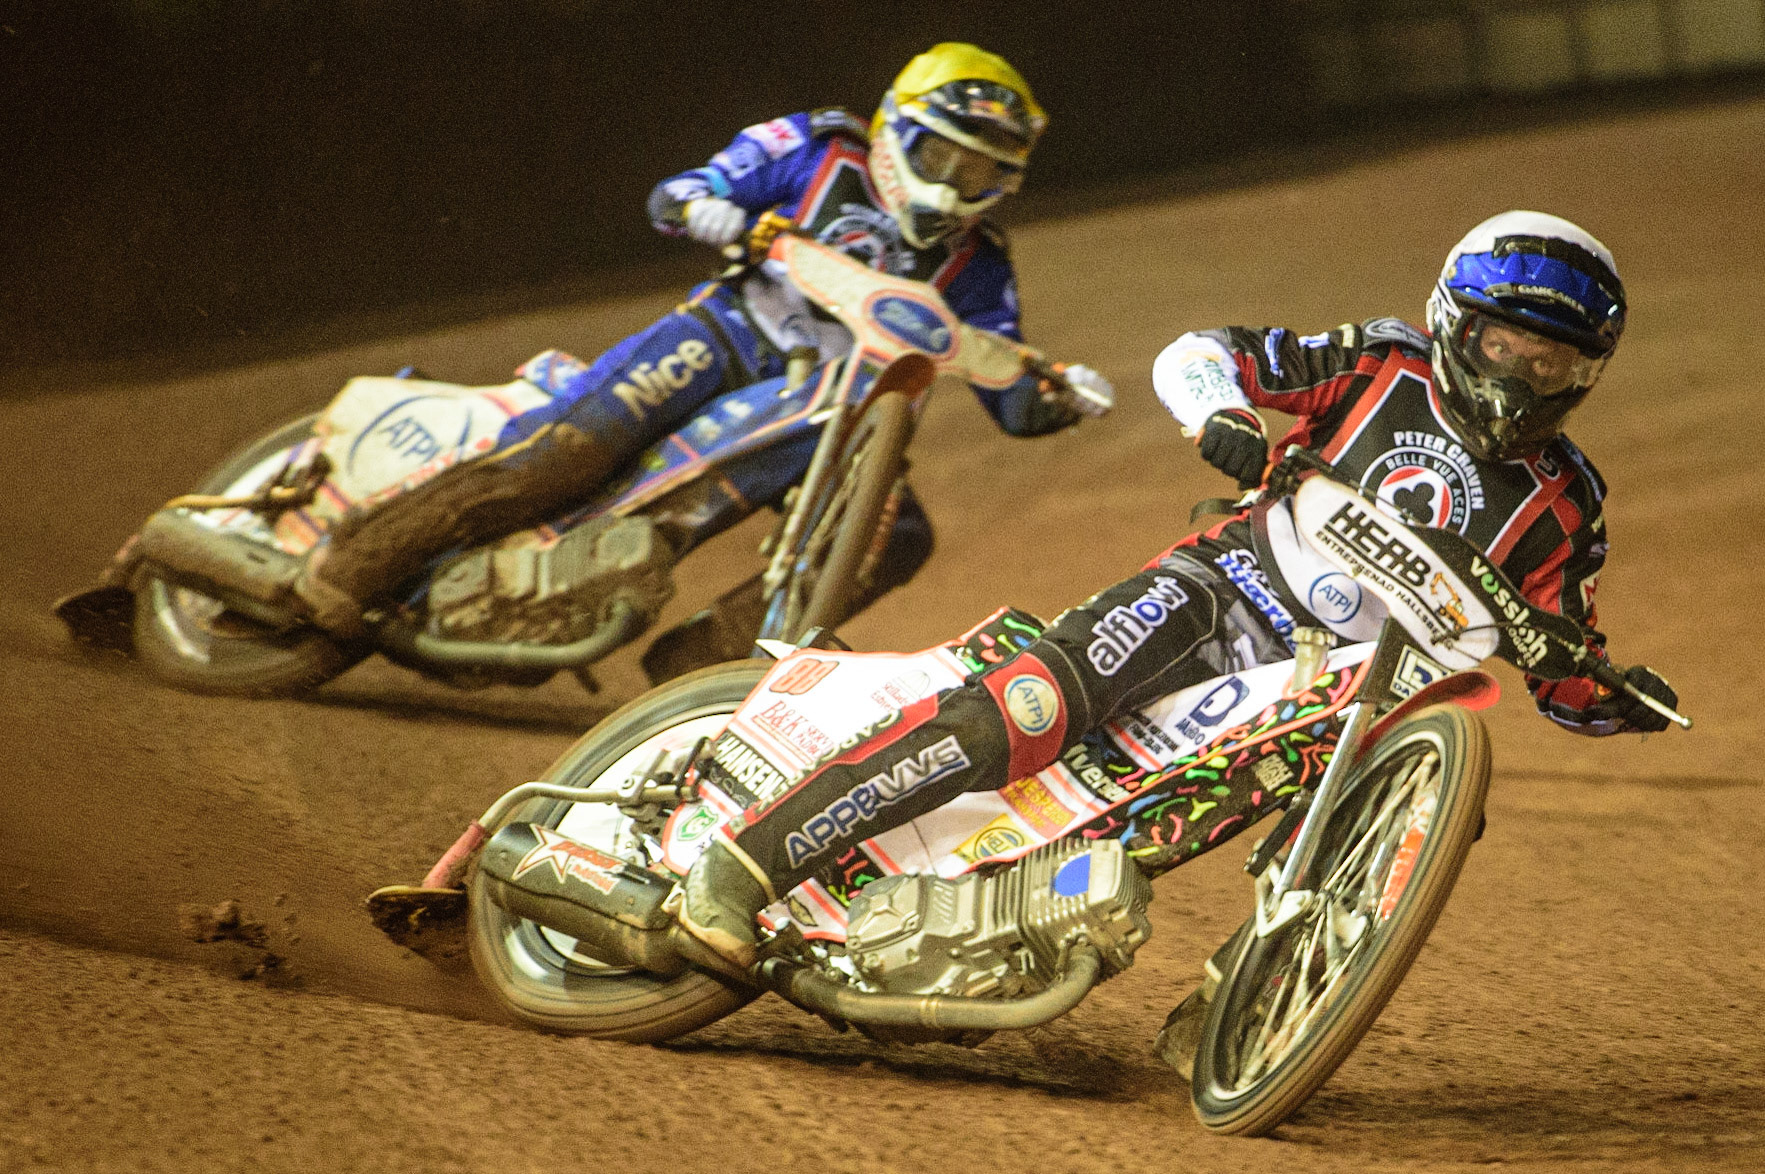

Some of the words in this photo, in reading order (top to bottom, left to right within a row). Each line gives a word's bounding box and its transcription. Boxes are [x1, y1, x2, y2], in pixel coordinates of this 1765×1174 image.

[612, 339, 714, 421] Nice
[1385, 453, 1427, 471] BELLE
[1432, 459, 1458, 484] VUE
[1451, 488, 1465, 525] ACES
[1393, 431, 1447, 452] PETER
[1446, 443, 1485, 510] CRAVEN
[1328, 501, 1431, 587] HEAB
[1318, 584, 1353, 613] ATPI
[1471, 555, 1548, 668] vossloh
[1018, 686, 1045, 725] ATPI
[714, 736, 785, 800] HANSEN
